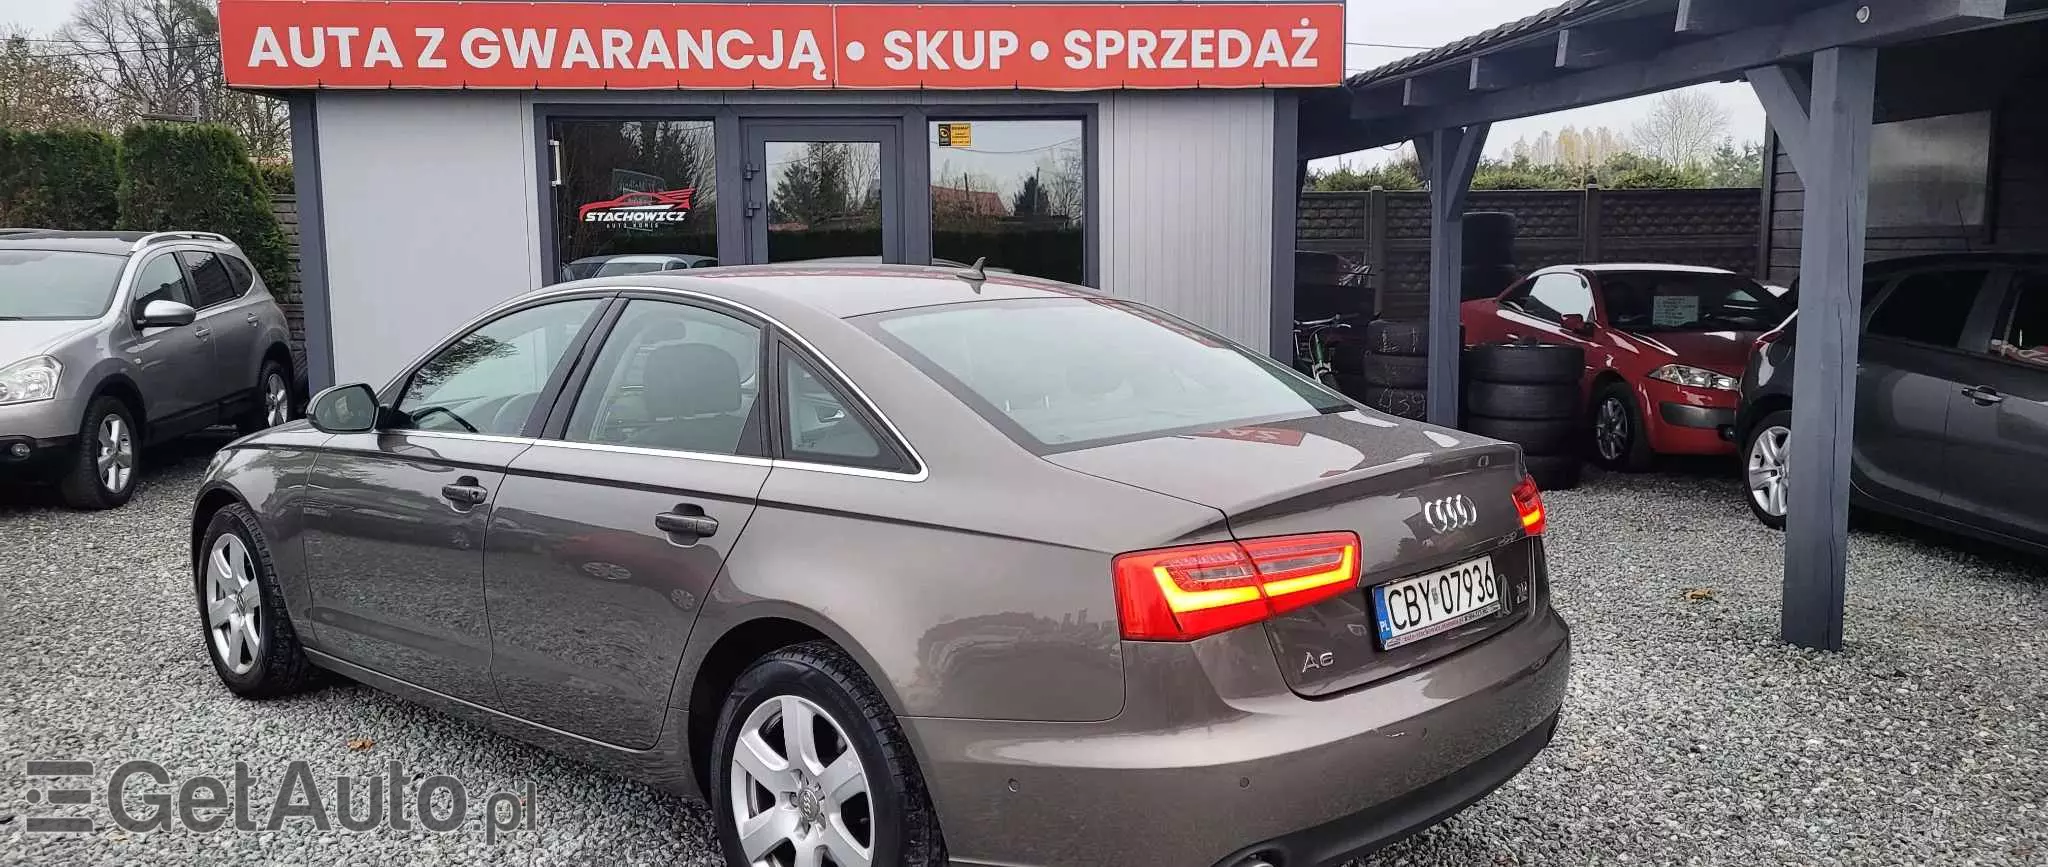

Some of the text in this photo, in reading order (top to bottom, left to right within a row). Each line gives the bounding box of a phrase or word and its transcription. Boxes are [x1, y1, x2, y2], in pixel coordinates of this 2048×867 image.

[247, 18, 1318, 81] AUTA Z GWARANCJĄ SKUP SPRZEDAŻ
[585, 211, 687, 222] STACHOWICZ
[1388, 580, 1433, 630] CBY
[1440, 560, 1495, 614] 07936
[1380, 620, 1391, 632] PL
[1302, 651, 1334, 672] A6
